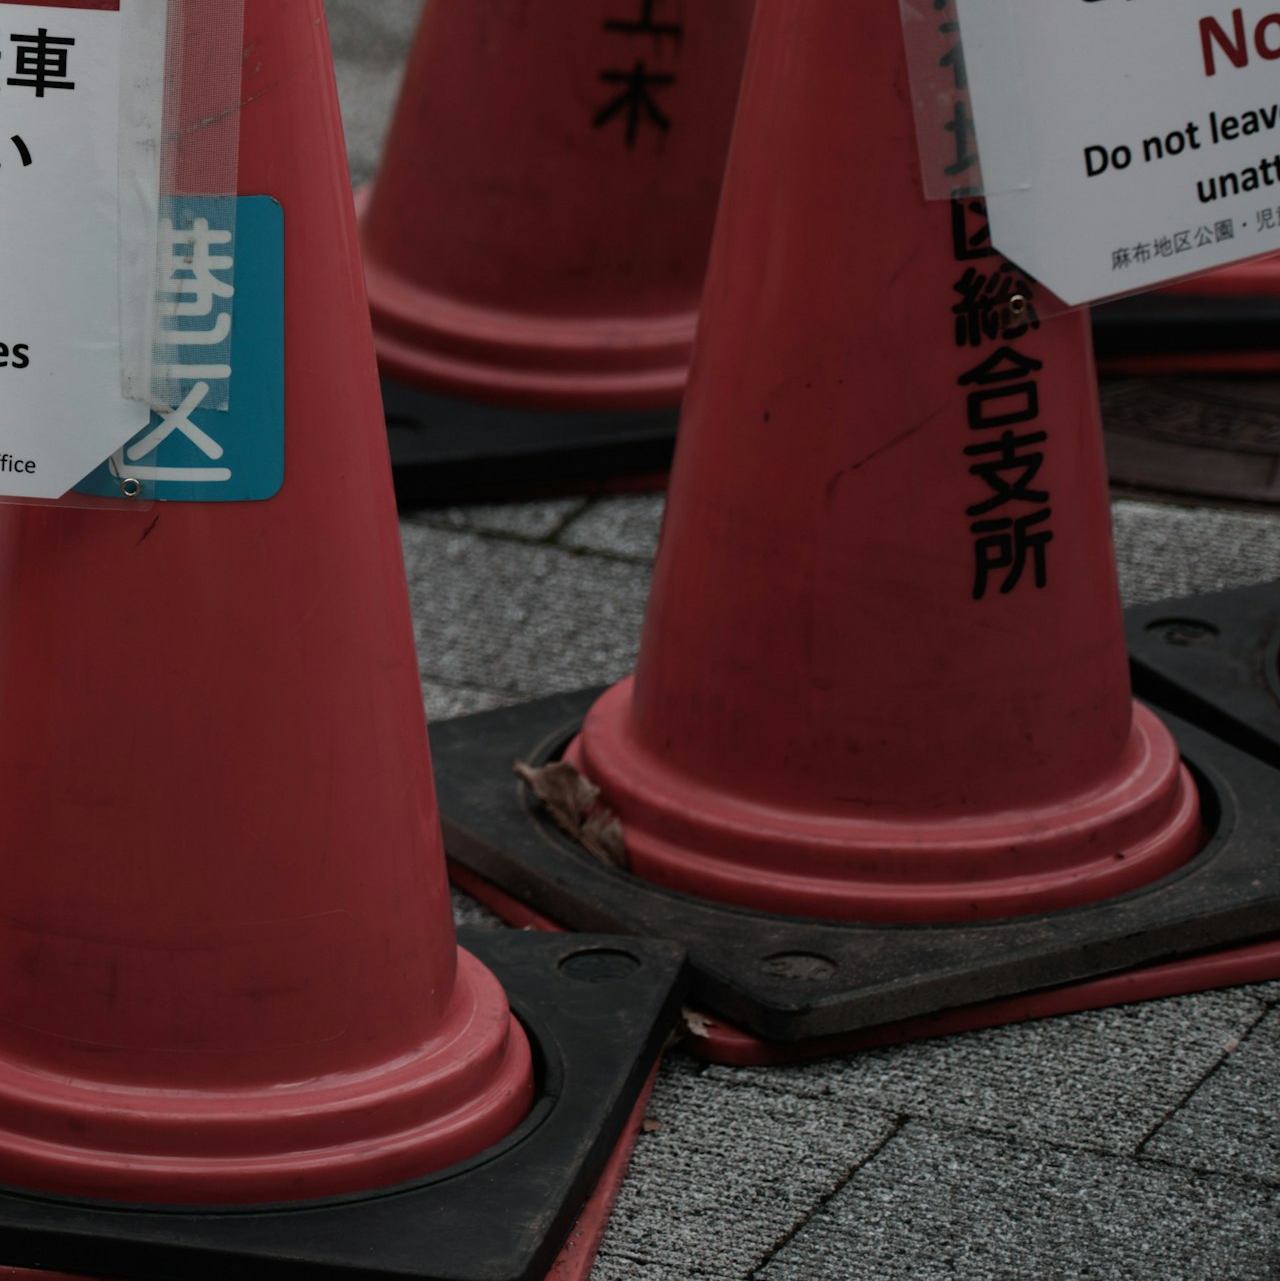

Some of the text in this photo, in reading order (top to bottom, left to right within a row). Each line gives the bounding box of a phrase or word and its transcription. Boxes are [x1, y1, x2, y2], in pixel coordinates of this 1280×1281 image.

[1083, 104, 1280, 177] Do not leav
